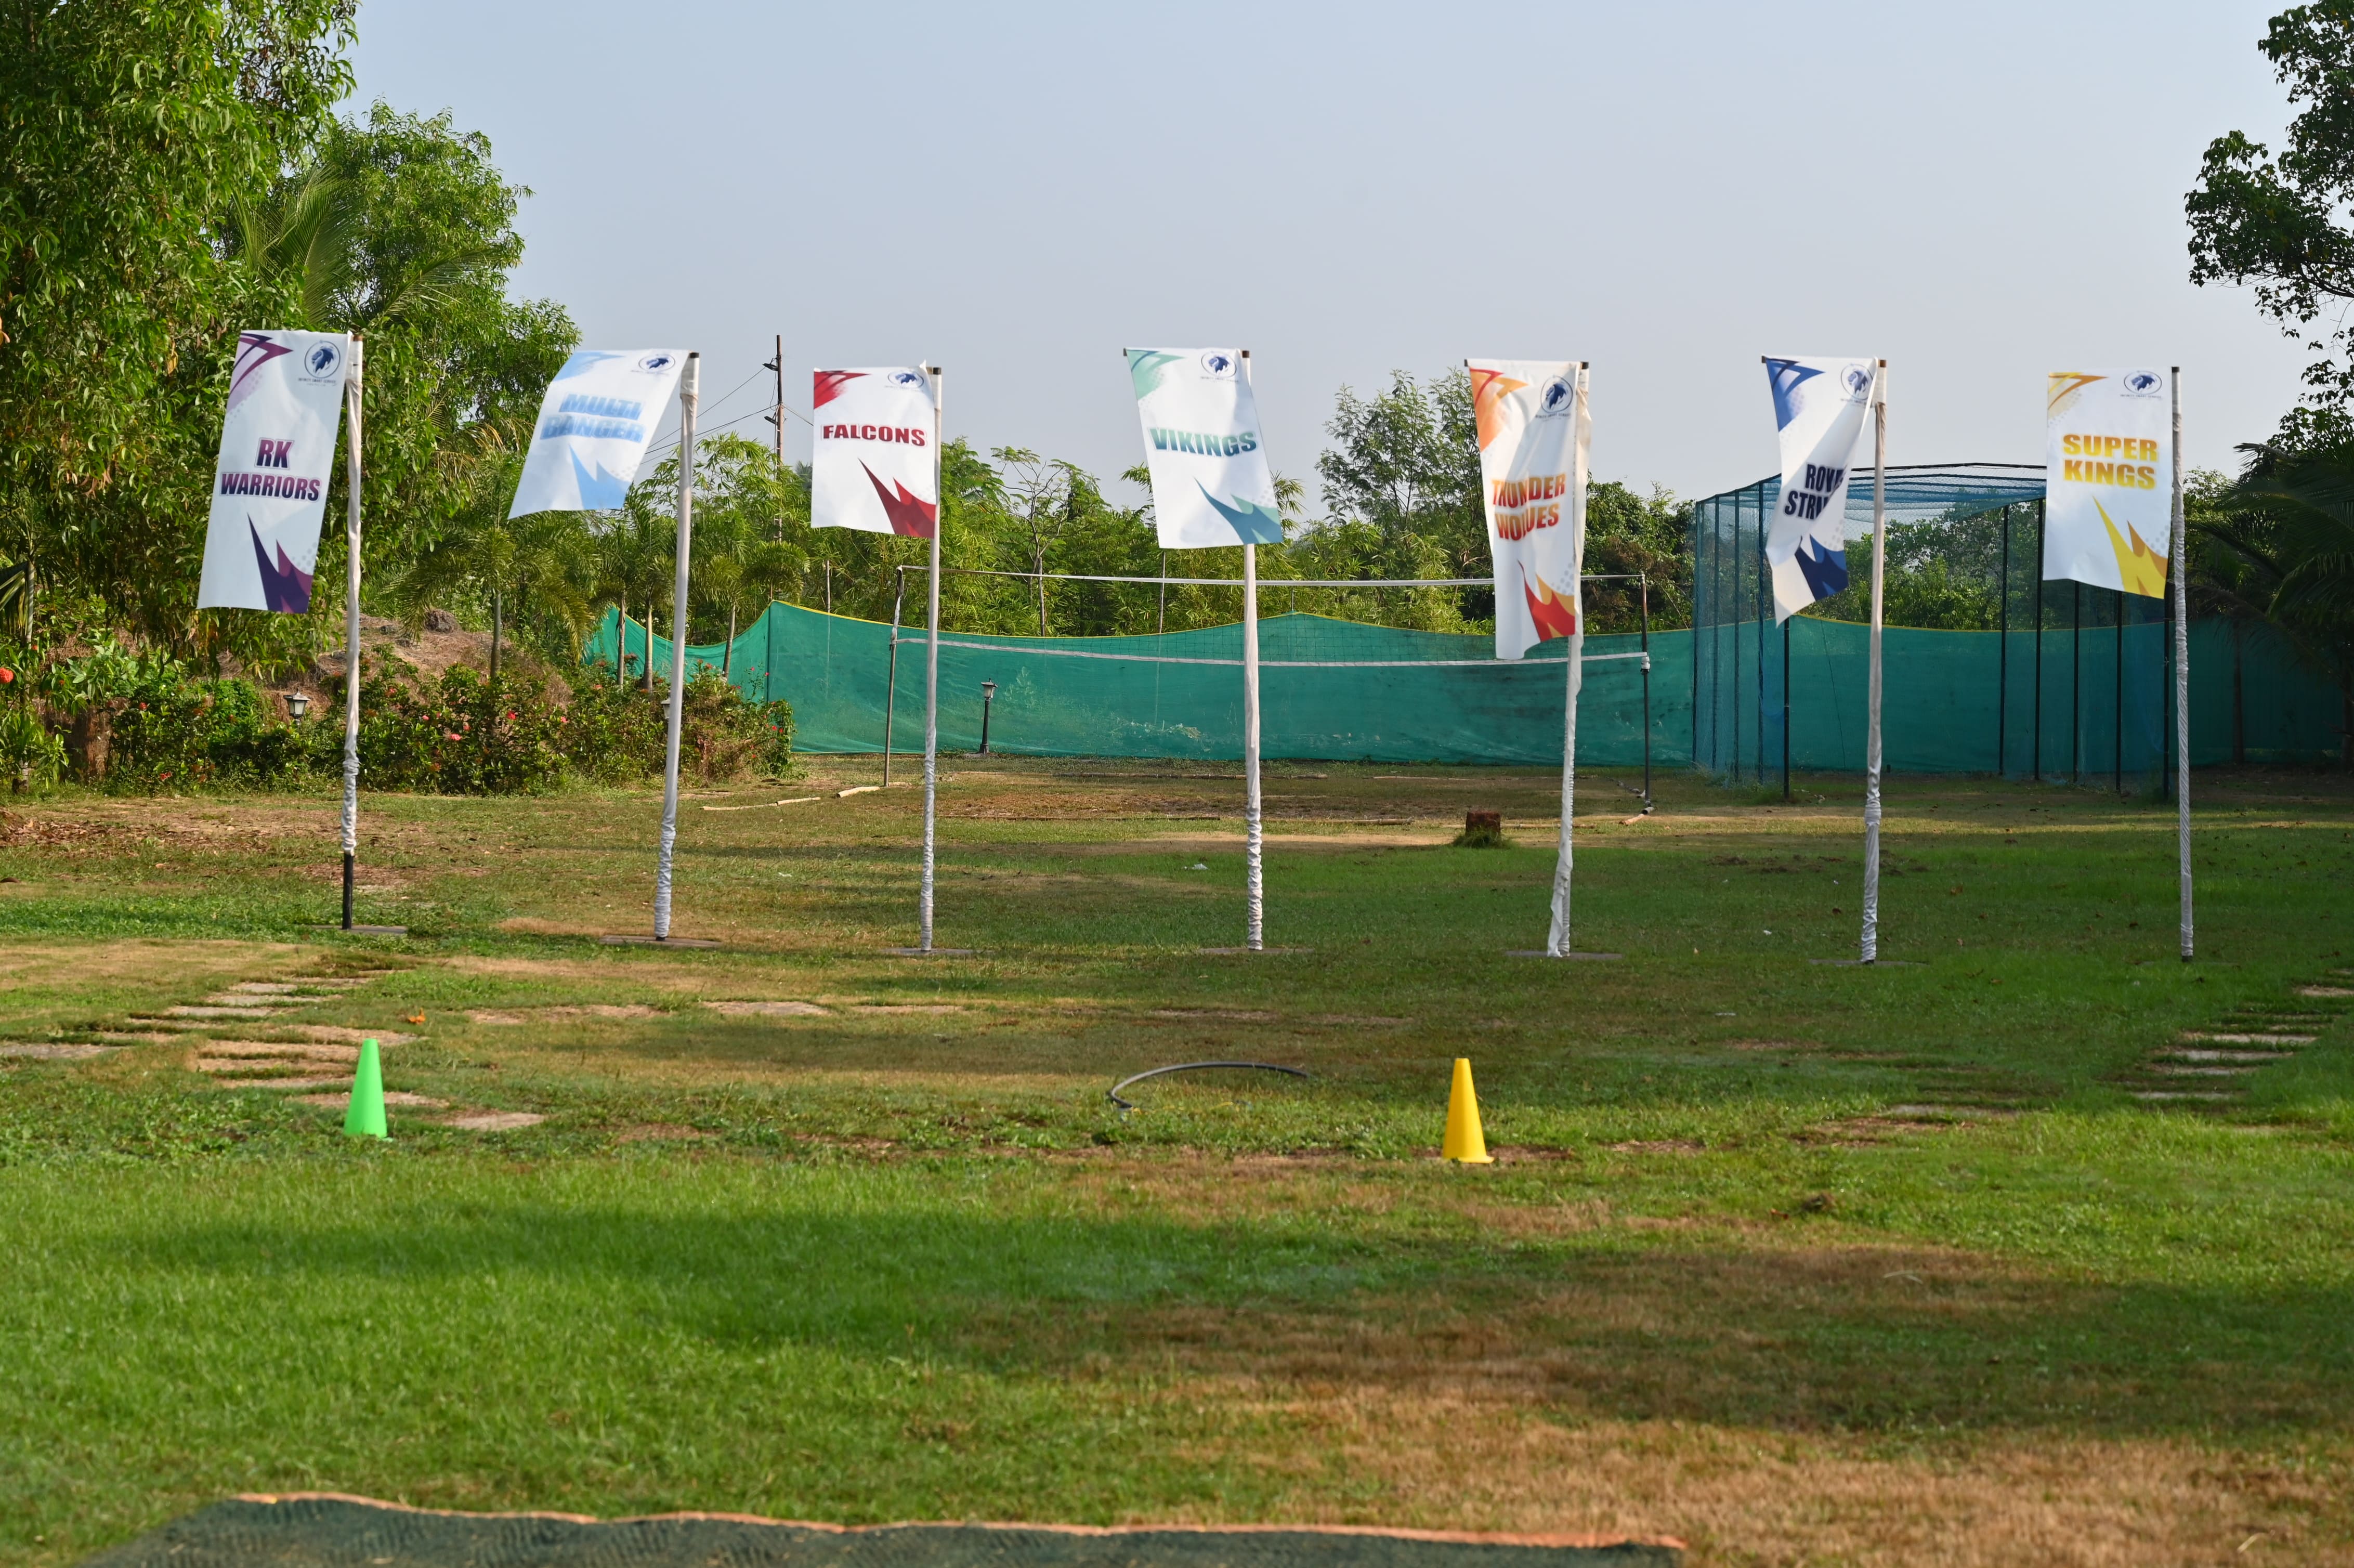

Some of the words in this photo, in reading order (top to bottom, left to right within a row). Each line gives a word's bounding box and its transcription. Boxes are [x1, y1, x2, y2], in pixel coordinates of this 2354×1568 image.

[558, 394, 643, 421] MULTI
[822, 424, 926, 447] FALCONS
[1148, 428, 1257, 457] VIKINGS
[2063, 434, 2159, 462] SUPER
[255, 438, 294, 469] RK
[220, 473, 321, 502] WARRIORS
[2063, 459, 2156, 490] KINGS
[1492, 474, 1566, 508] THUNDER
